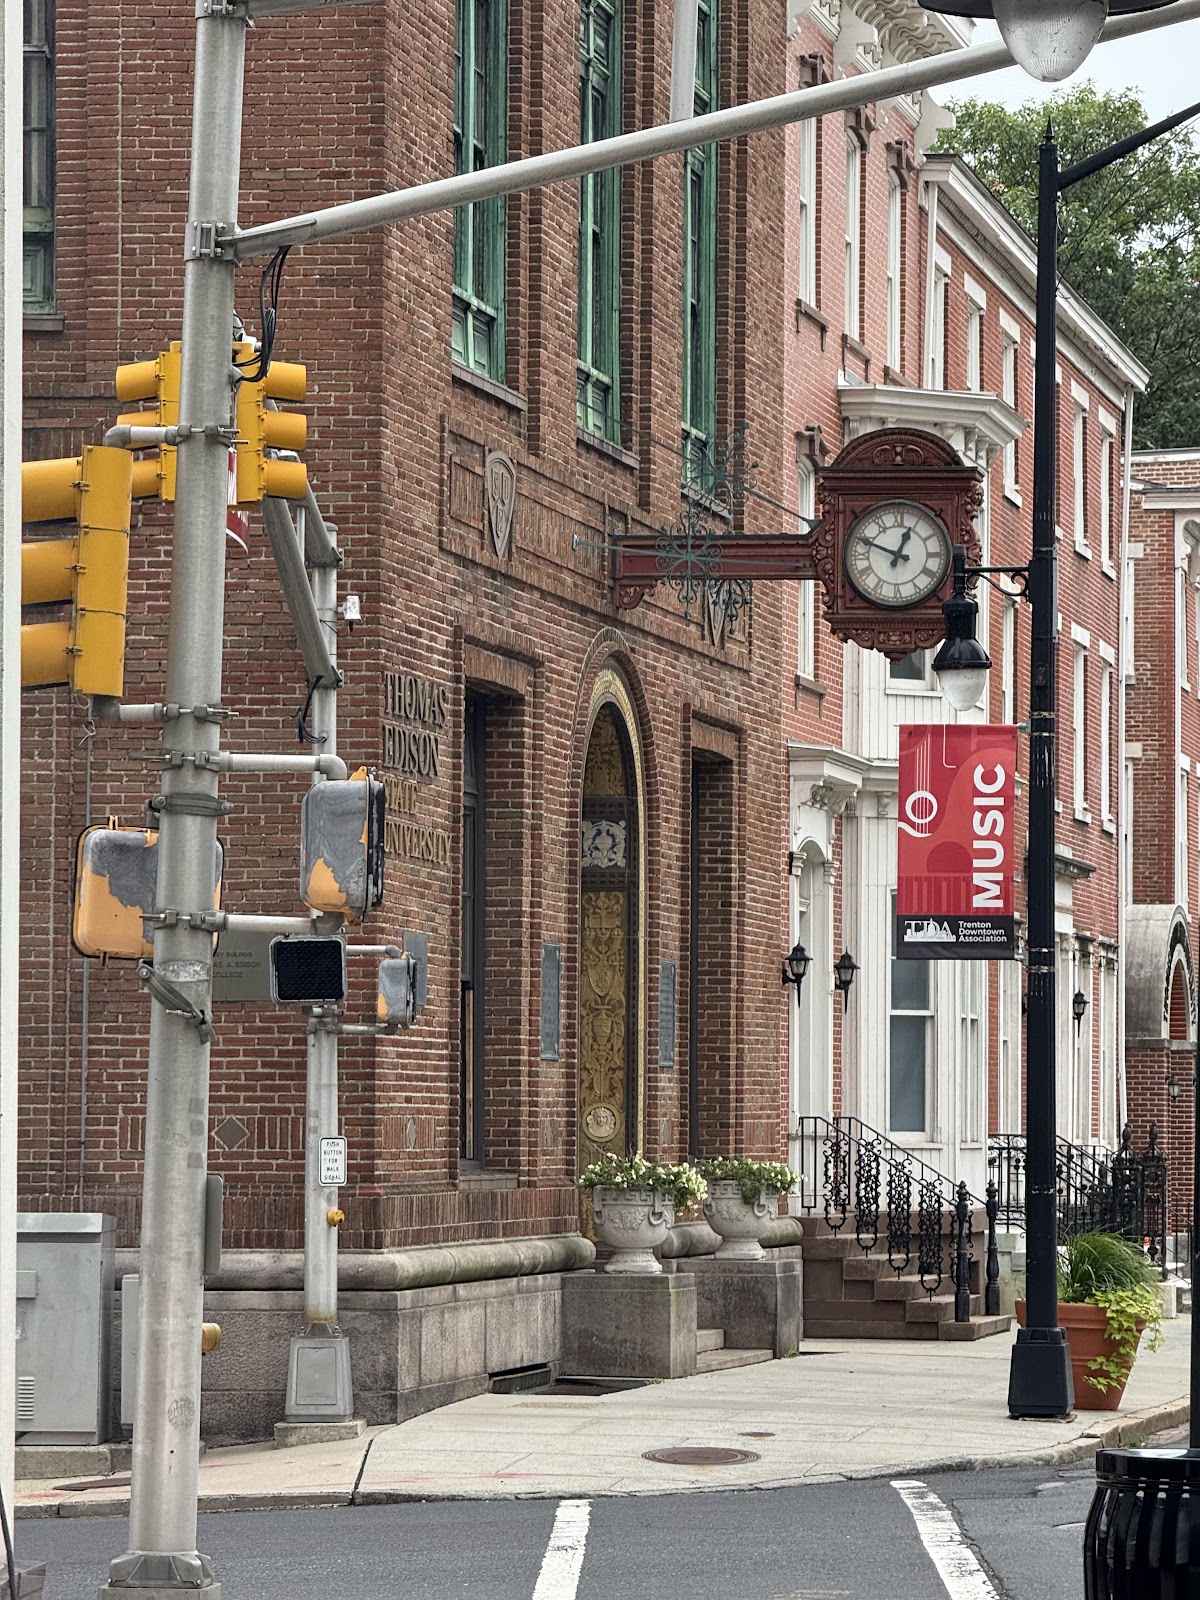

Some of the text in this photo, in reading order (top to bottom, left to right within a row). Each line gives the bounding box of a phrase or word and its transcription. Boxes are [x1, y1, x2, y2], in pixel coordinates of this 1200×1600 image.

[382, 670, 448, 728] THOMAS
[382, 724, 439, 778] EDISON
[383, 776, 418, 815] STATE
[384, 821, 453, 864] UNIVERSITY
[973, 763, 1005, 908] MUSIC
[958, 920, 992, 929] Trenton
[958, 928, 1005, 936] Downtown
[958, 934, 1008, 943] Association
